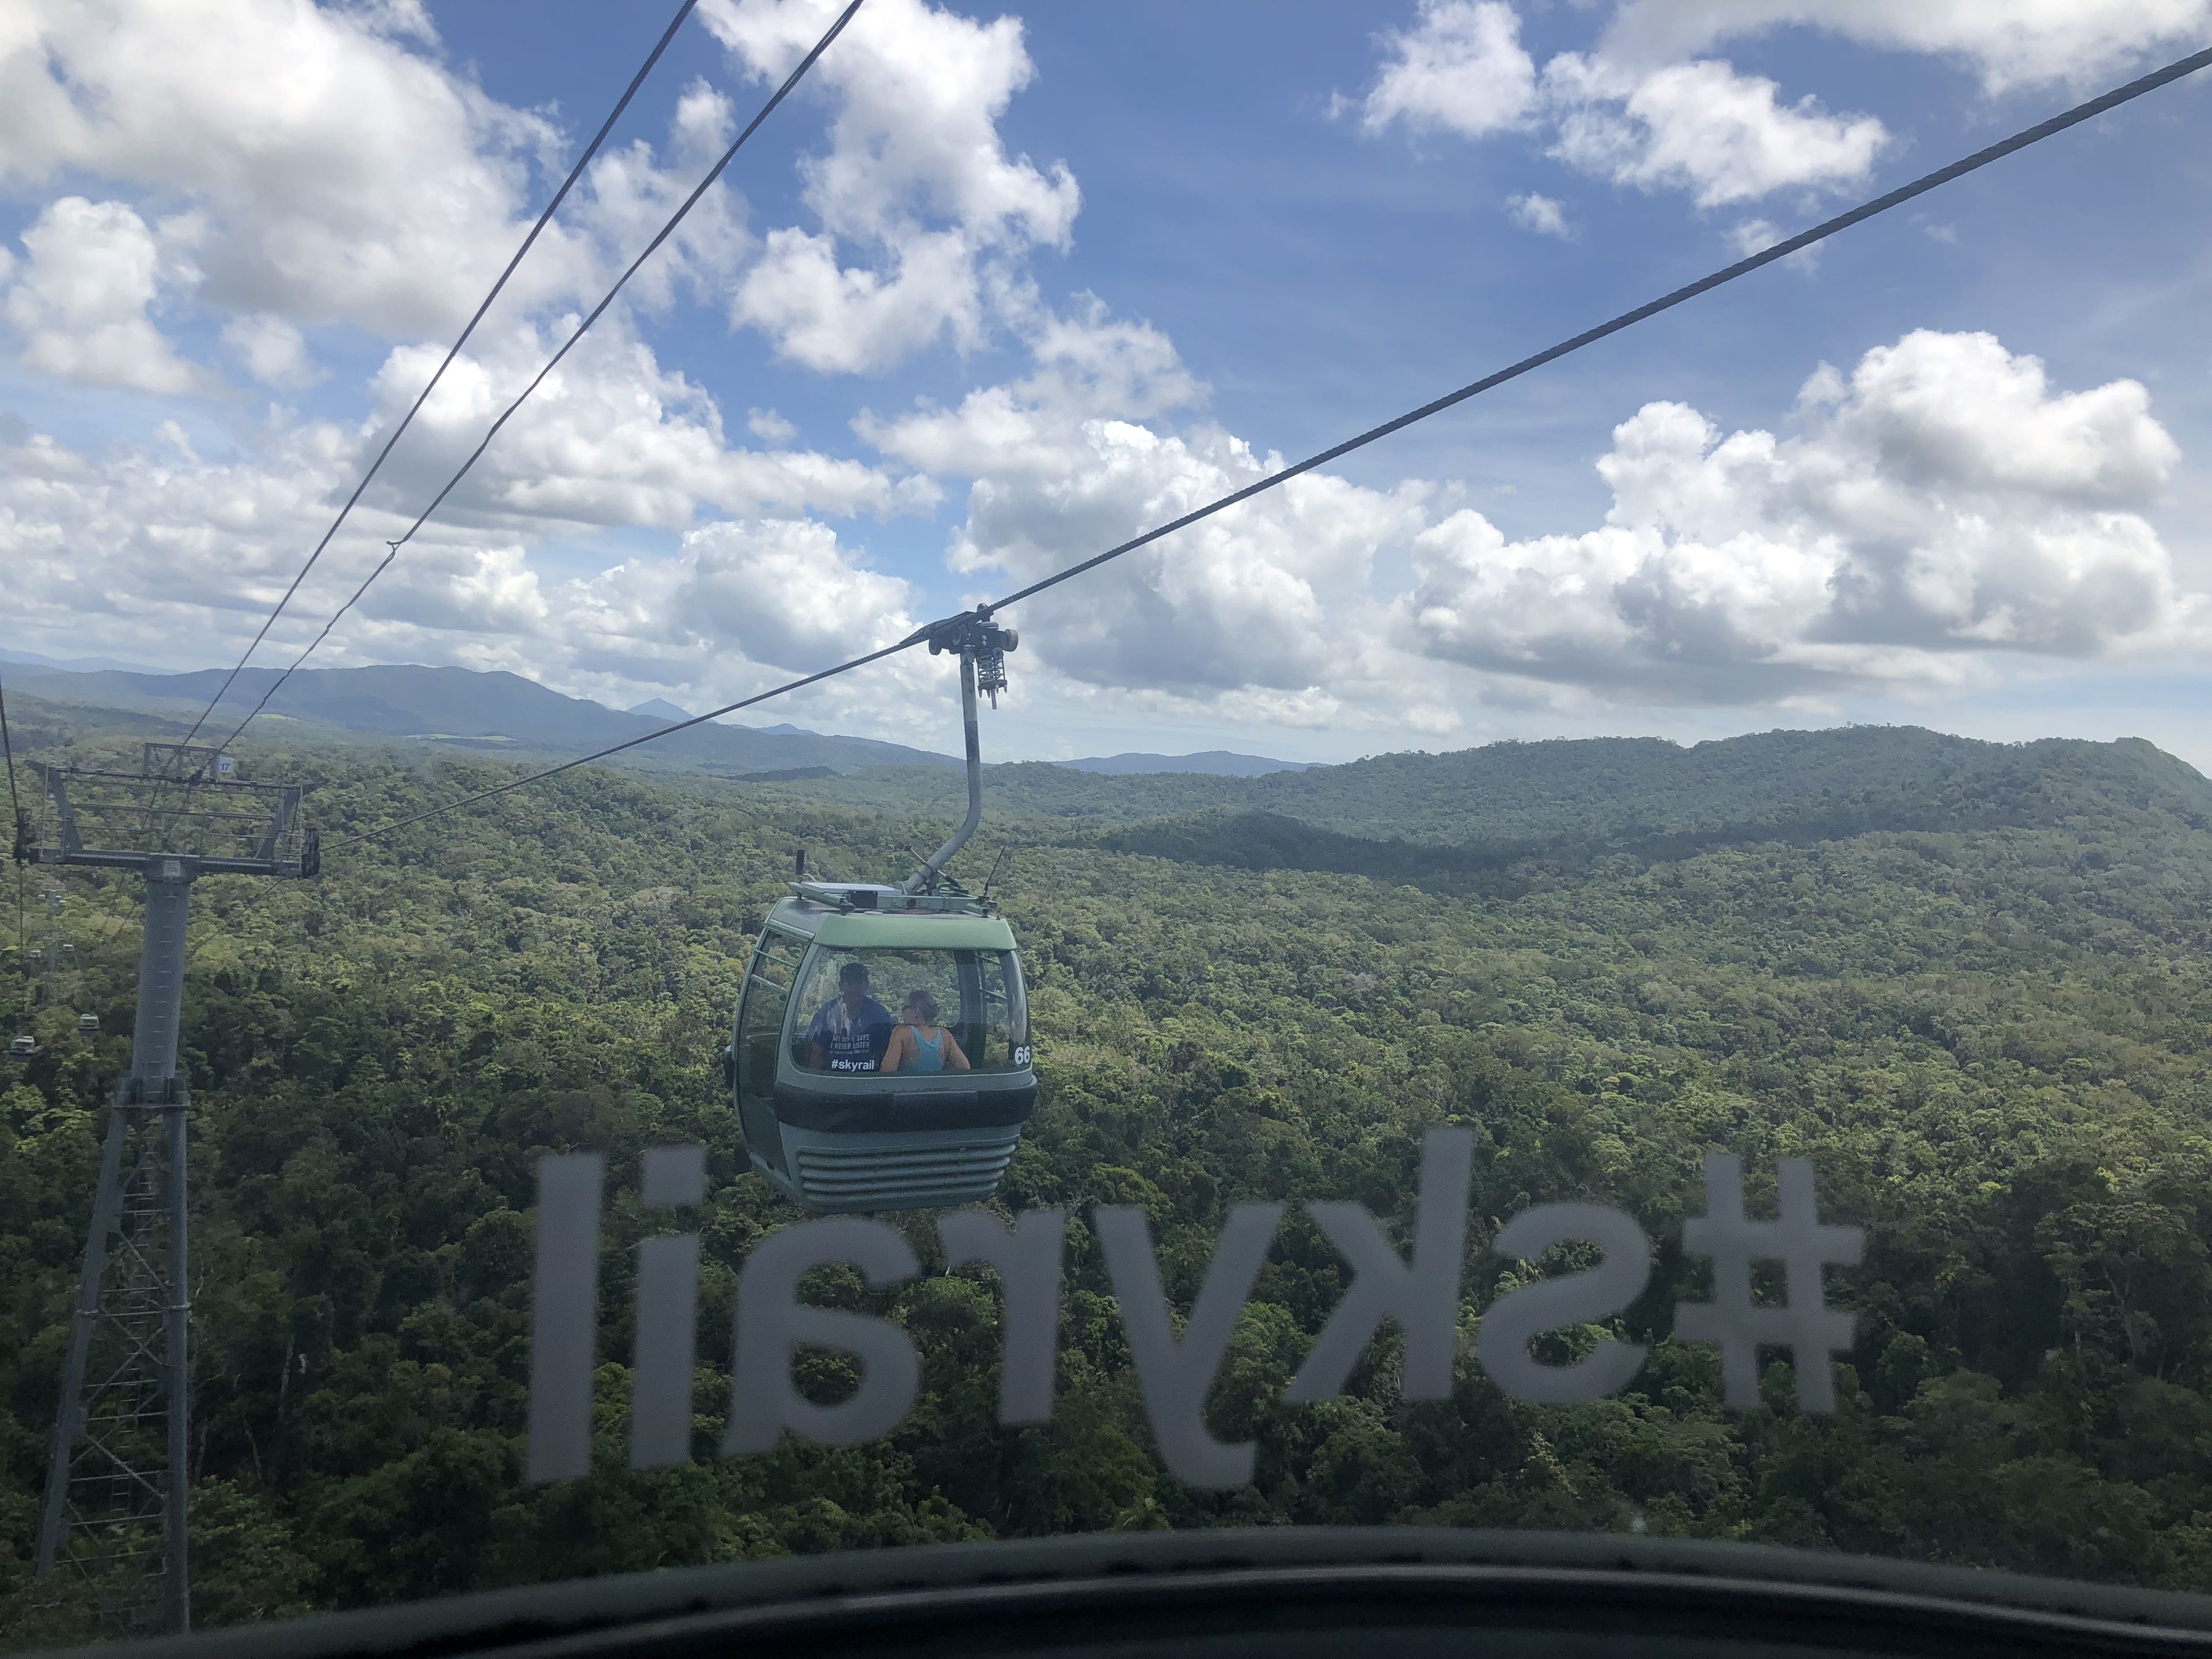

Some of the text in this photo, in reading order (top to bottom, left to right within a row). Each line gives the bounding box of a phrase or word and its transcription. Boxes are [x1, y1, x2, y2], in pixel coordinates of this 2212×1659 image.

[221, 763, 230, 771] 17
[1014, 1046, 1031, 1065] 66
[831, 1059, 875, 1071] #skyrail
